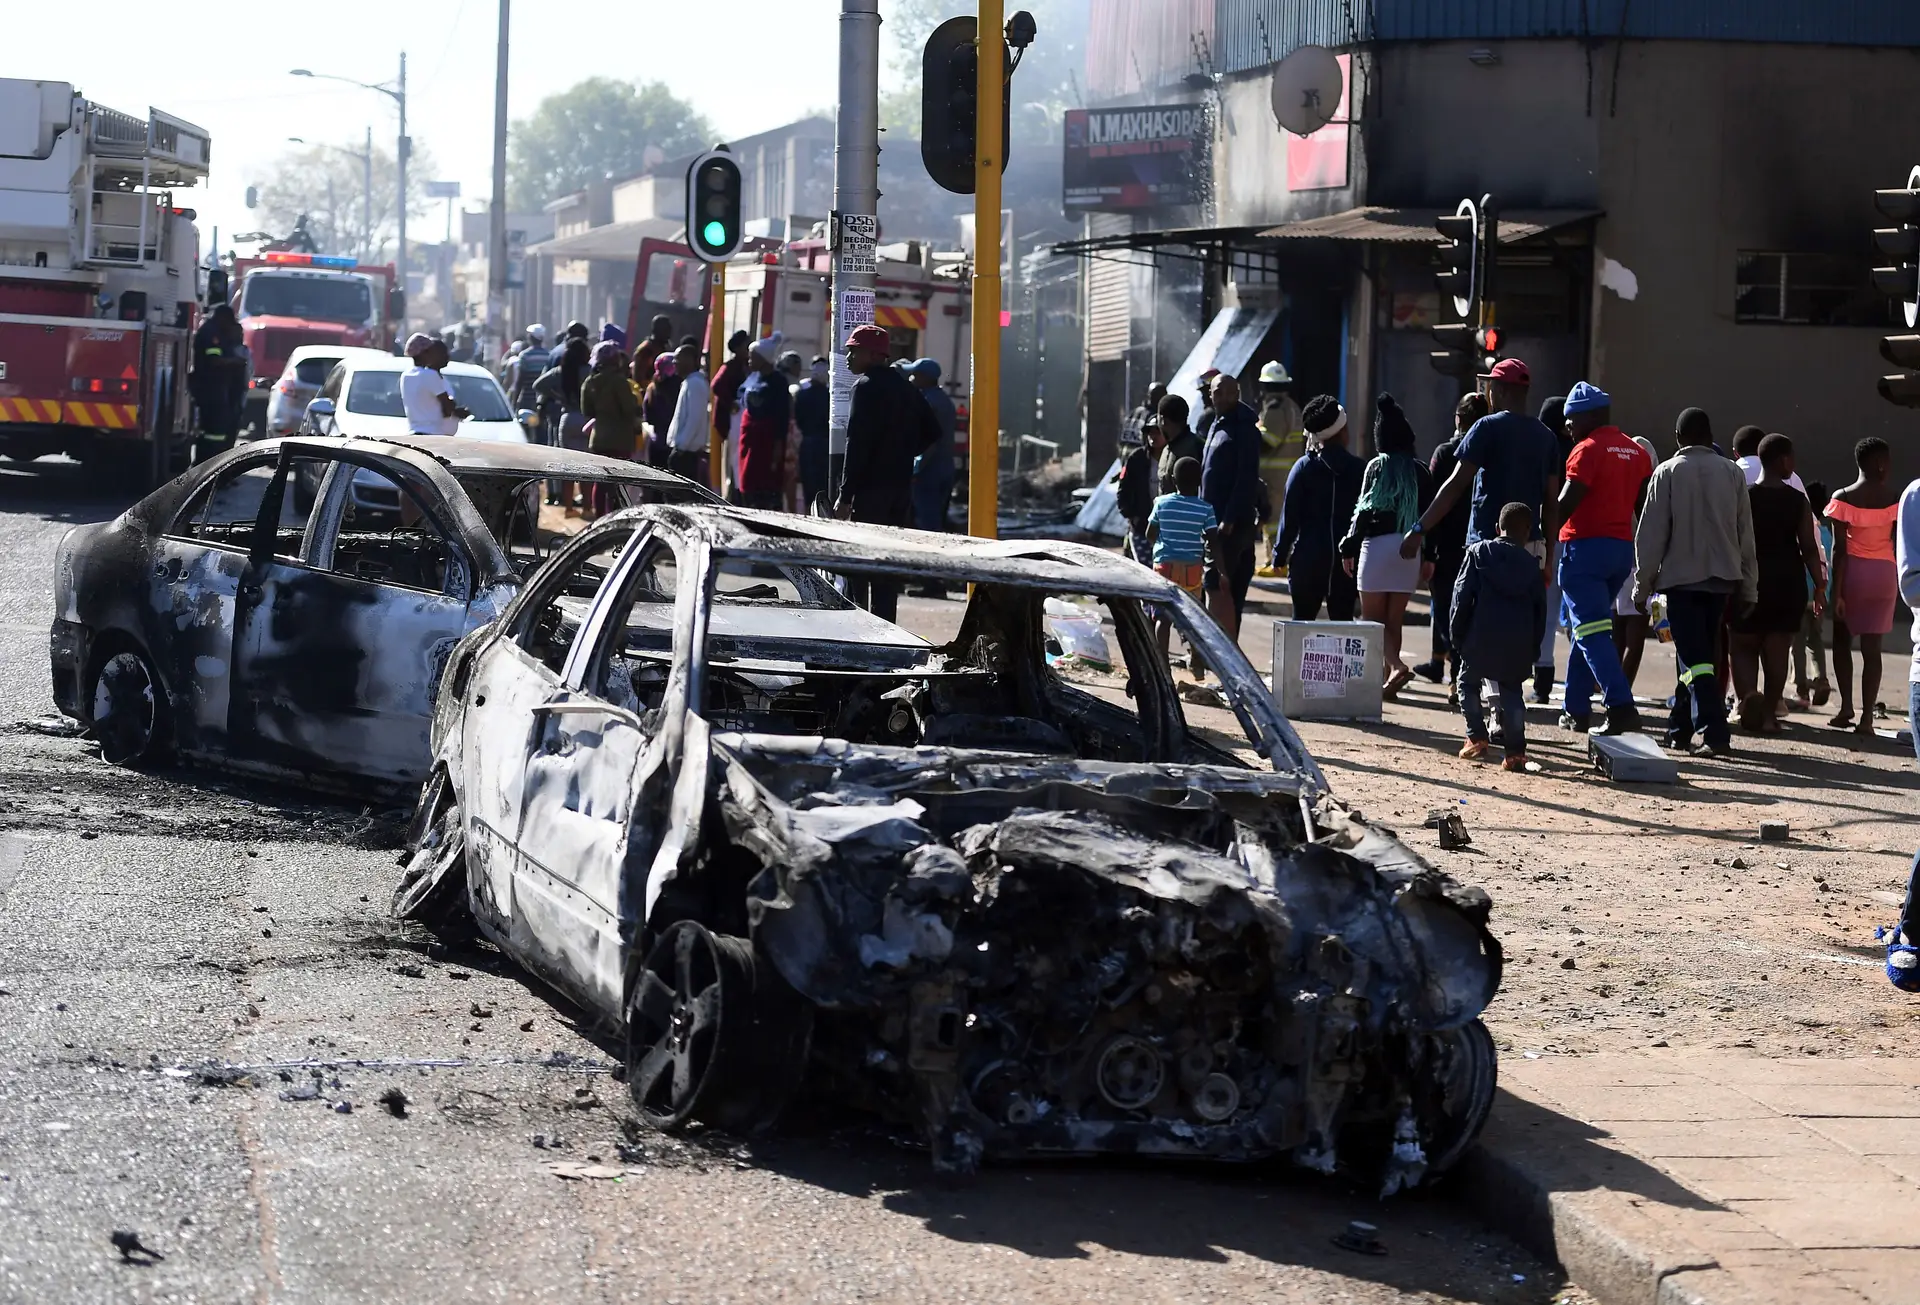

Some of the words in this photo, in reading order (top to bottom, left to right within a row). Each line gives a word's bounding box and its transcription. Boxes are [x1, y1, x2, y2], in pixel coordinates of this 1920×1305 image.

[845, 295, 875, 303] ABORTI
[1303, 653, 1343, 664] ABORTION
[1301, 669, 1313, 680] 078
[1314, 670, 1326, 681] 508
[1327, 672, 1341, 683] 1333
